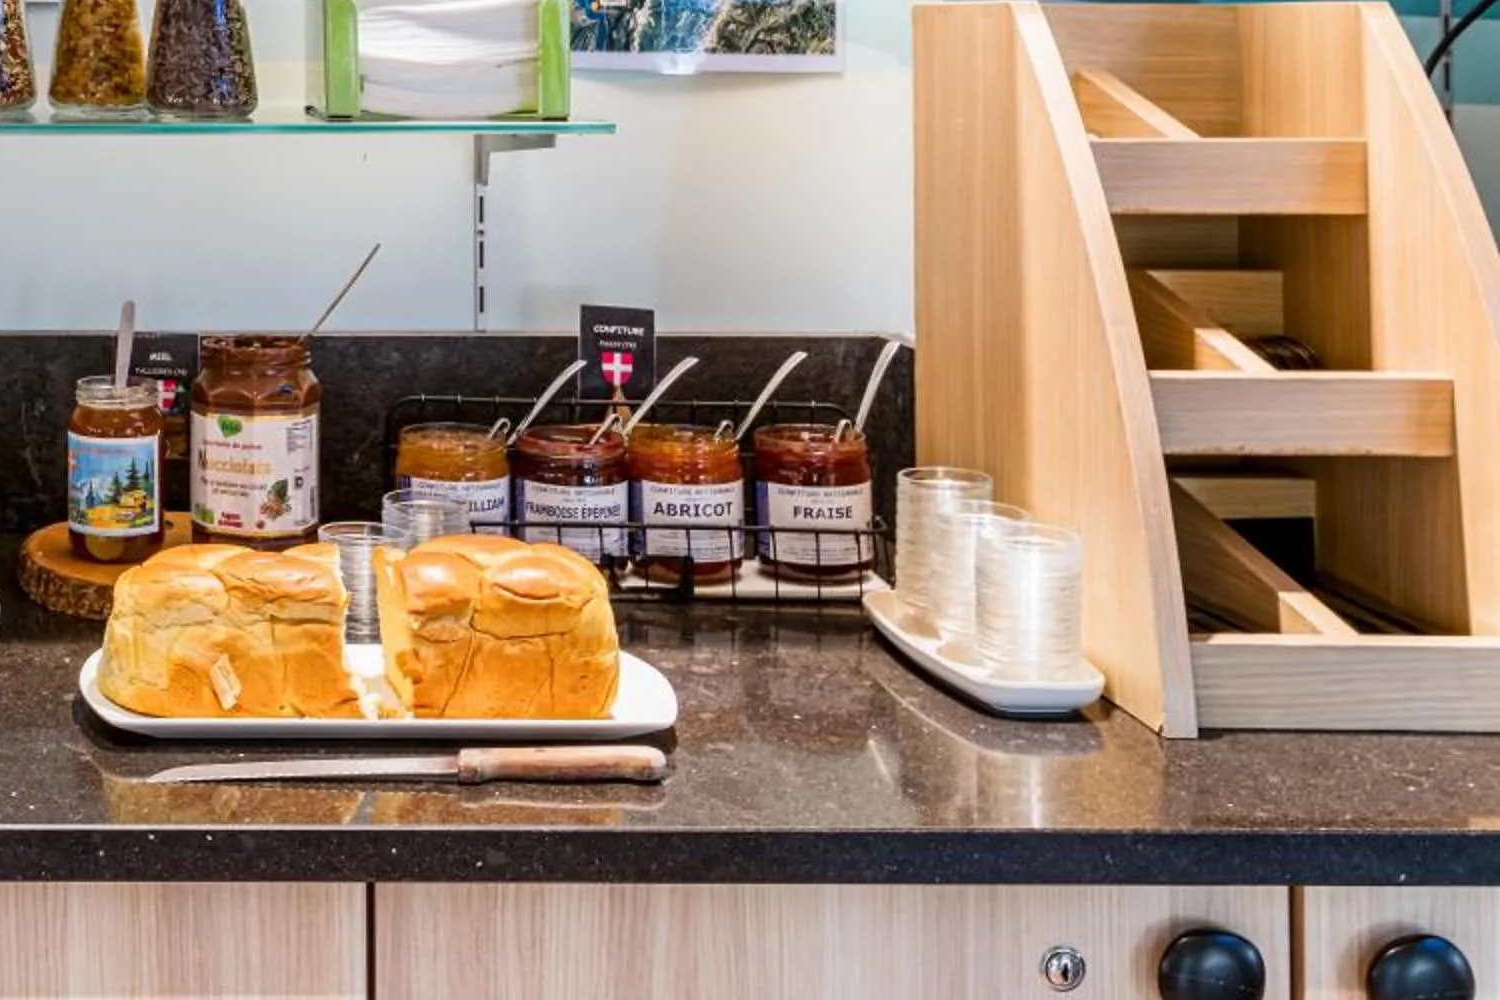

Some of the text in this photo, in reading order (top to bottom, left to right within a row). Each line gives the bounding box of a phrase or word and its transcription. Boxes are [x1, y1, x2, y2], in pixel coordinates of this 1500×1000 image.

[593, 324, 645, 336] CONFITURE
[467, 496, 505, 513] ILLIAM
[526, 501, 579, 519] FRAMBOISE
[653, 501, 733, 517] ABRICOT
[793, 505, 853, 519] FRAISE
